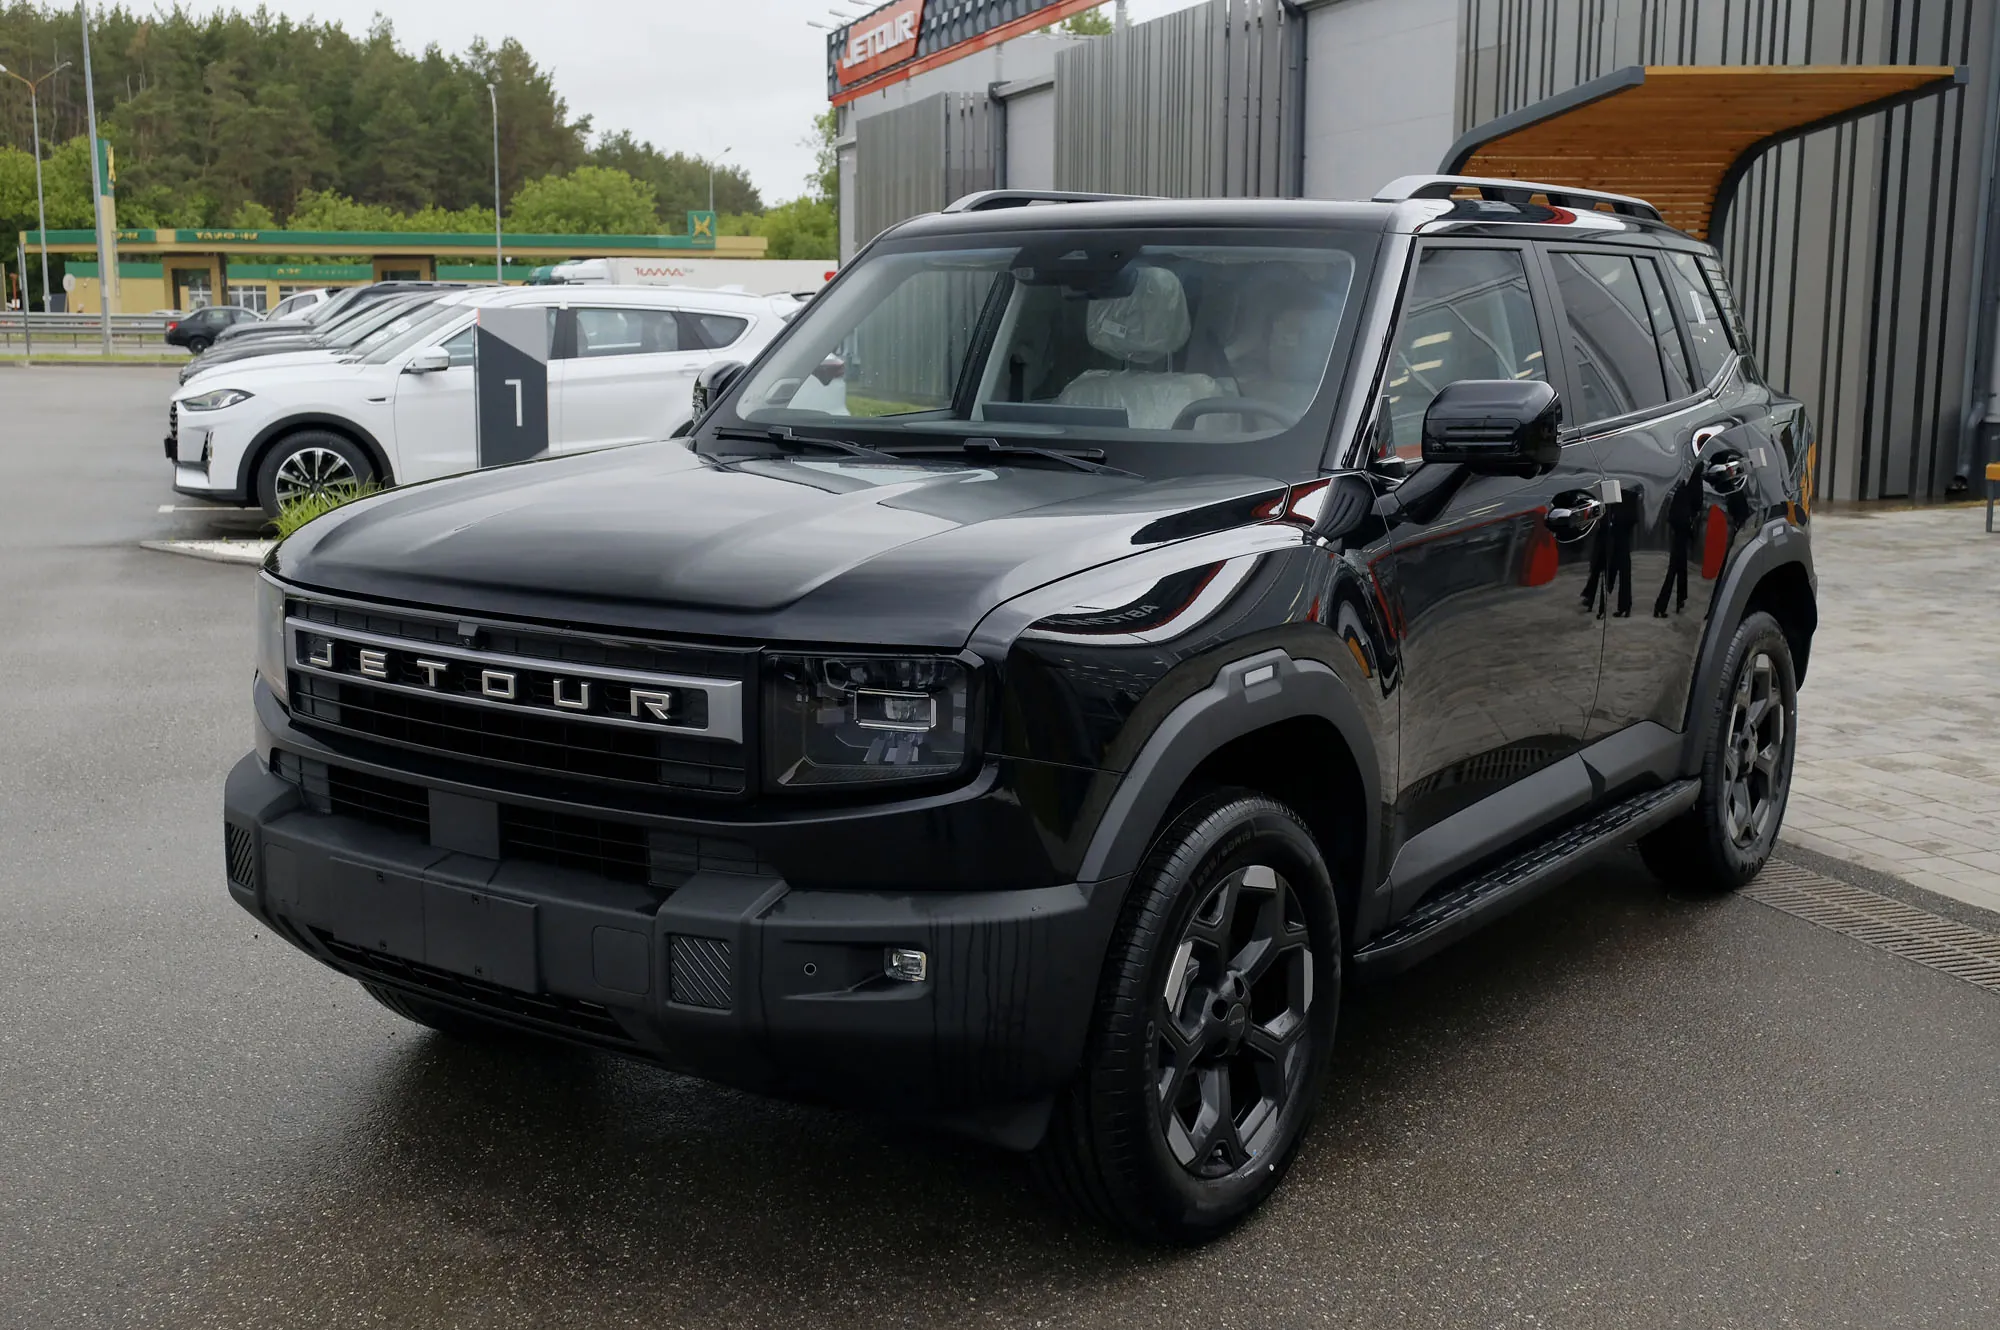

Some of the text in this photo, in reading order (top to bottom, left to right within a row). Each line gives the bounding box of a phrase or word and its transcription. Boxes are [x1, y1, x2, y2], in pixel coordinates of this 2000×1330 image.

[843, 10, 915, 69] JETOUR
[505, 379, 523, 426] 1
[309, 638, 673, 721] JETOUR
